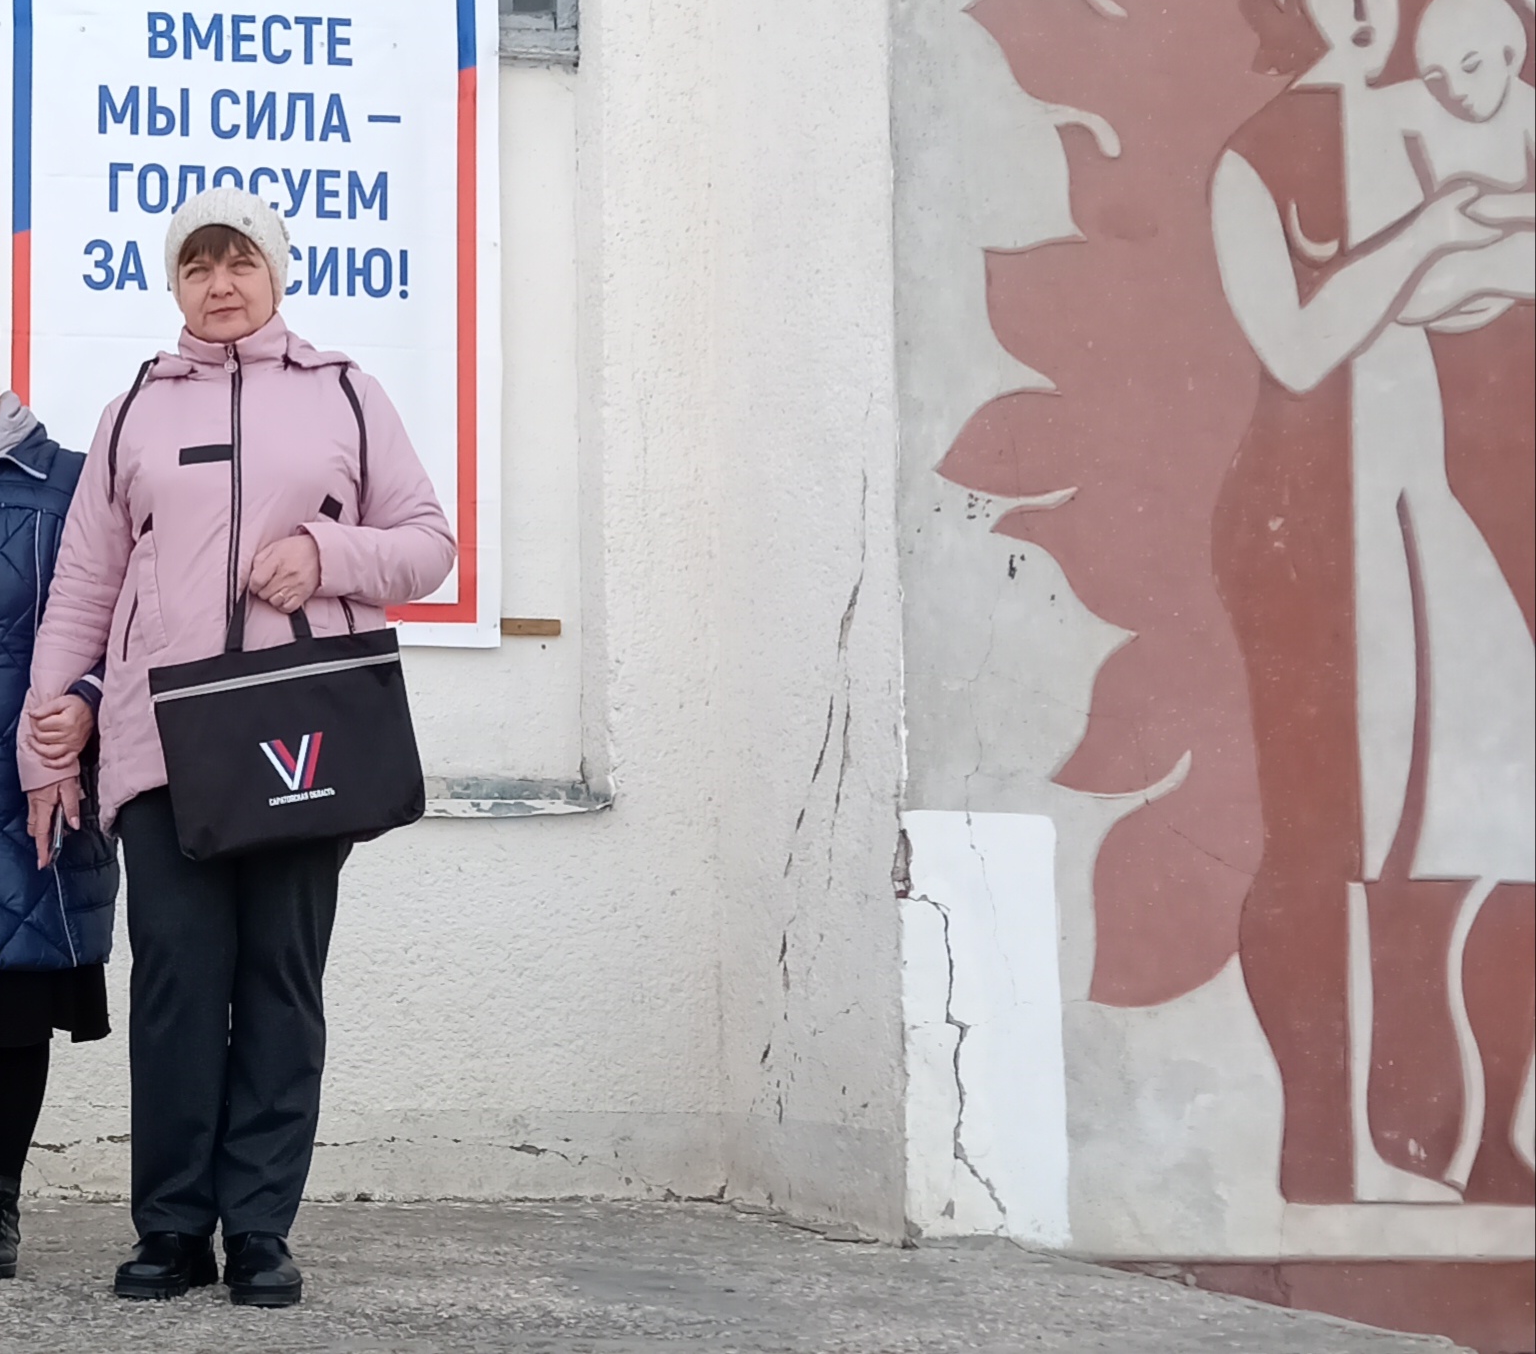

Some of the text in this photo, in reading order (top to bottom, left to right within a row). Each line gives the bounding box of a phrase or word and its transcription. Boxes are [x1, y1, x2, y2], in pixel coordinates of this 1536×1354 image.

[147, 11, 354, 67] ВМЕСТЕ
[97, 84, 190, 137] МЫ
[210, 88, 352, 143] СИЛА
[82, 238, 410, 300] ЗА СИЮ!
